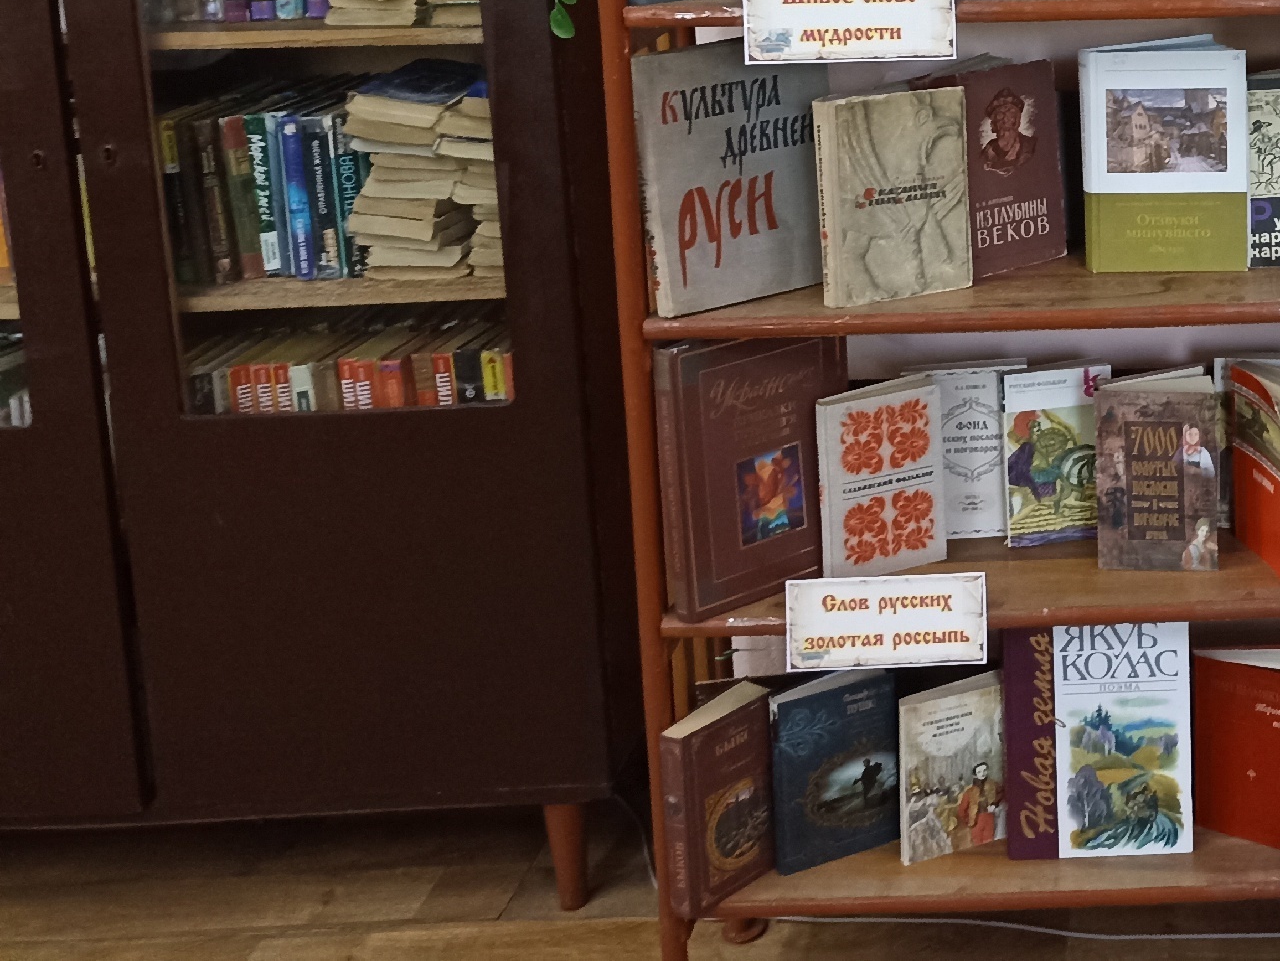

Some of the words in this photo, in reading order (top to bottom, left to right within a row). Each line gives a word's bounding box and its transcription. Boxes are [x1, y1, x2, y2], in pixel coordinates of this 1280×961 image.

[800, 25, 902, 47] мудрости
[247, 133, 269, 187] Морской
[976, 208, 993, 229] ИЗ
[994, 198, 1048, 224] ГЛУБИНЫ
[977, 215, 1050, 248] ВЕКОВ
[1131, 426, 1178, 457] 7000
[821, 594, 870, 613] Слов
[878, 593, 953, 614] русских
[804, 632, 885, 651] золотая
[892, 629, 970, 651] россыпь
[1060, 623, 1159, 663] ЯКУБ
[1061, 648, 1179, 682] КОЛАС
[1099, 682, 1141, 692] ПОЭМА
[1019, 737, 1056, 839] Новая
